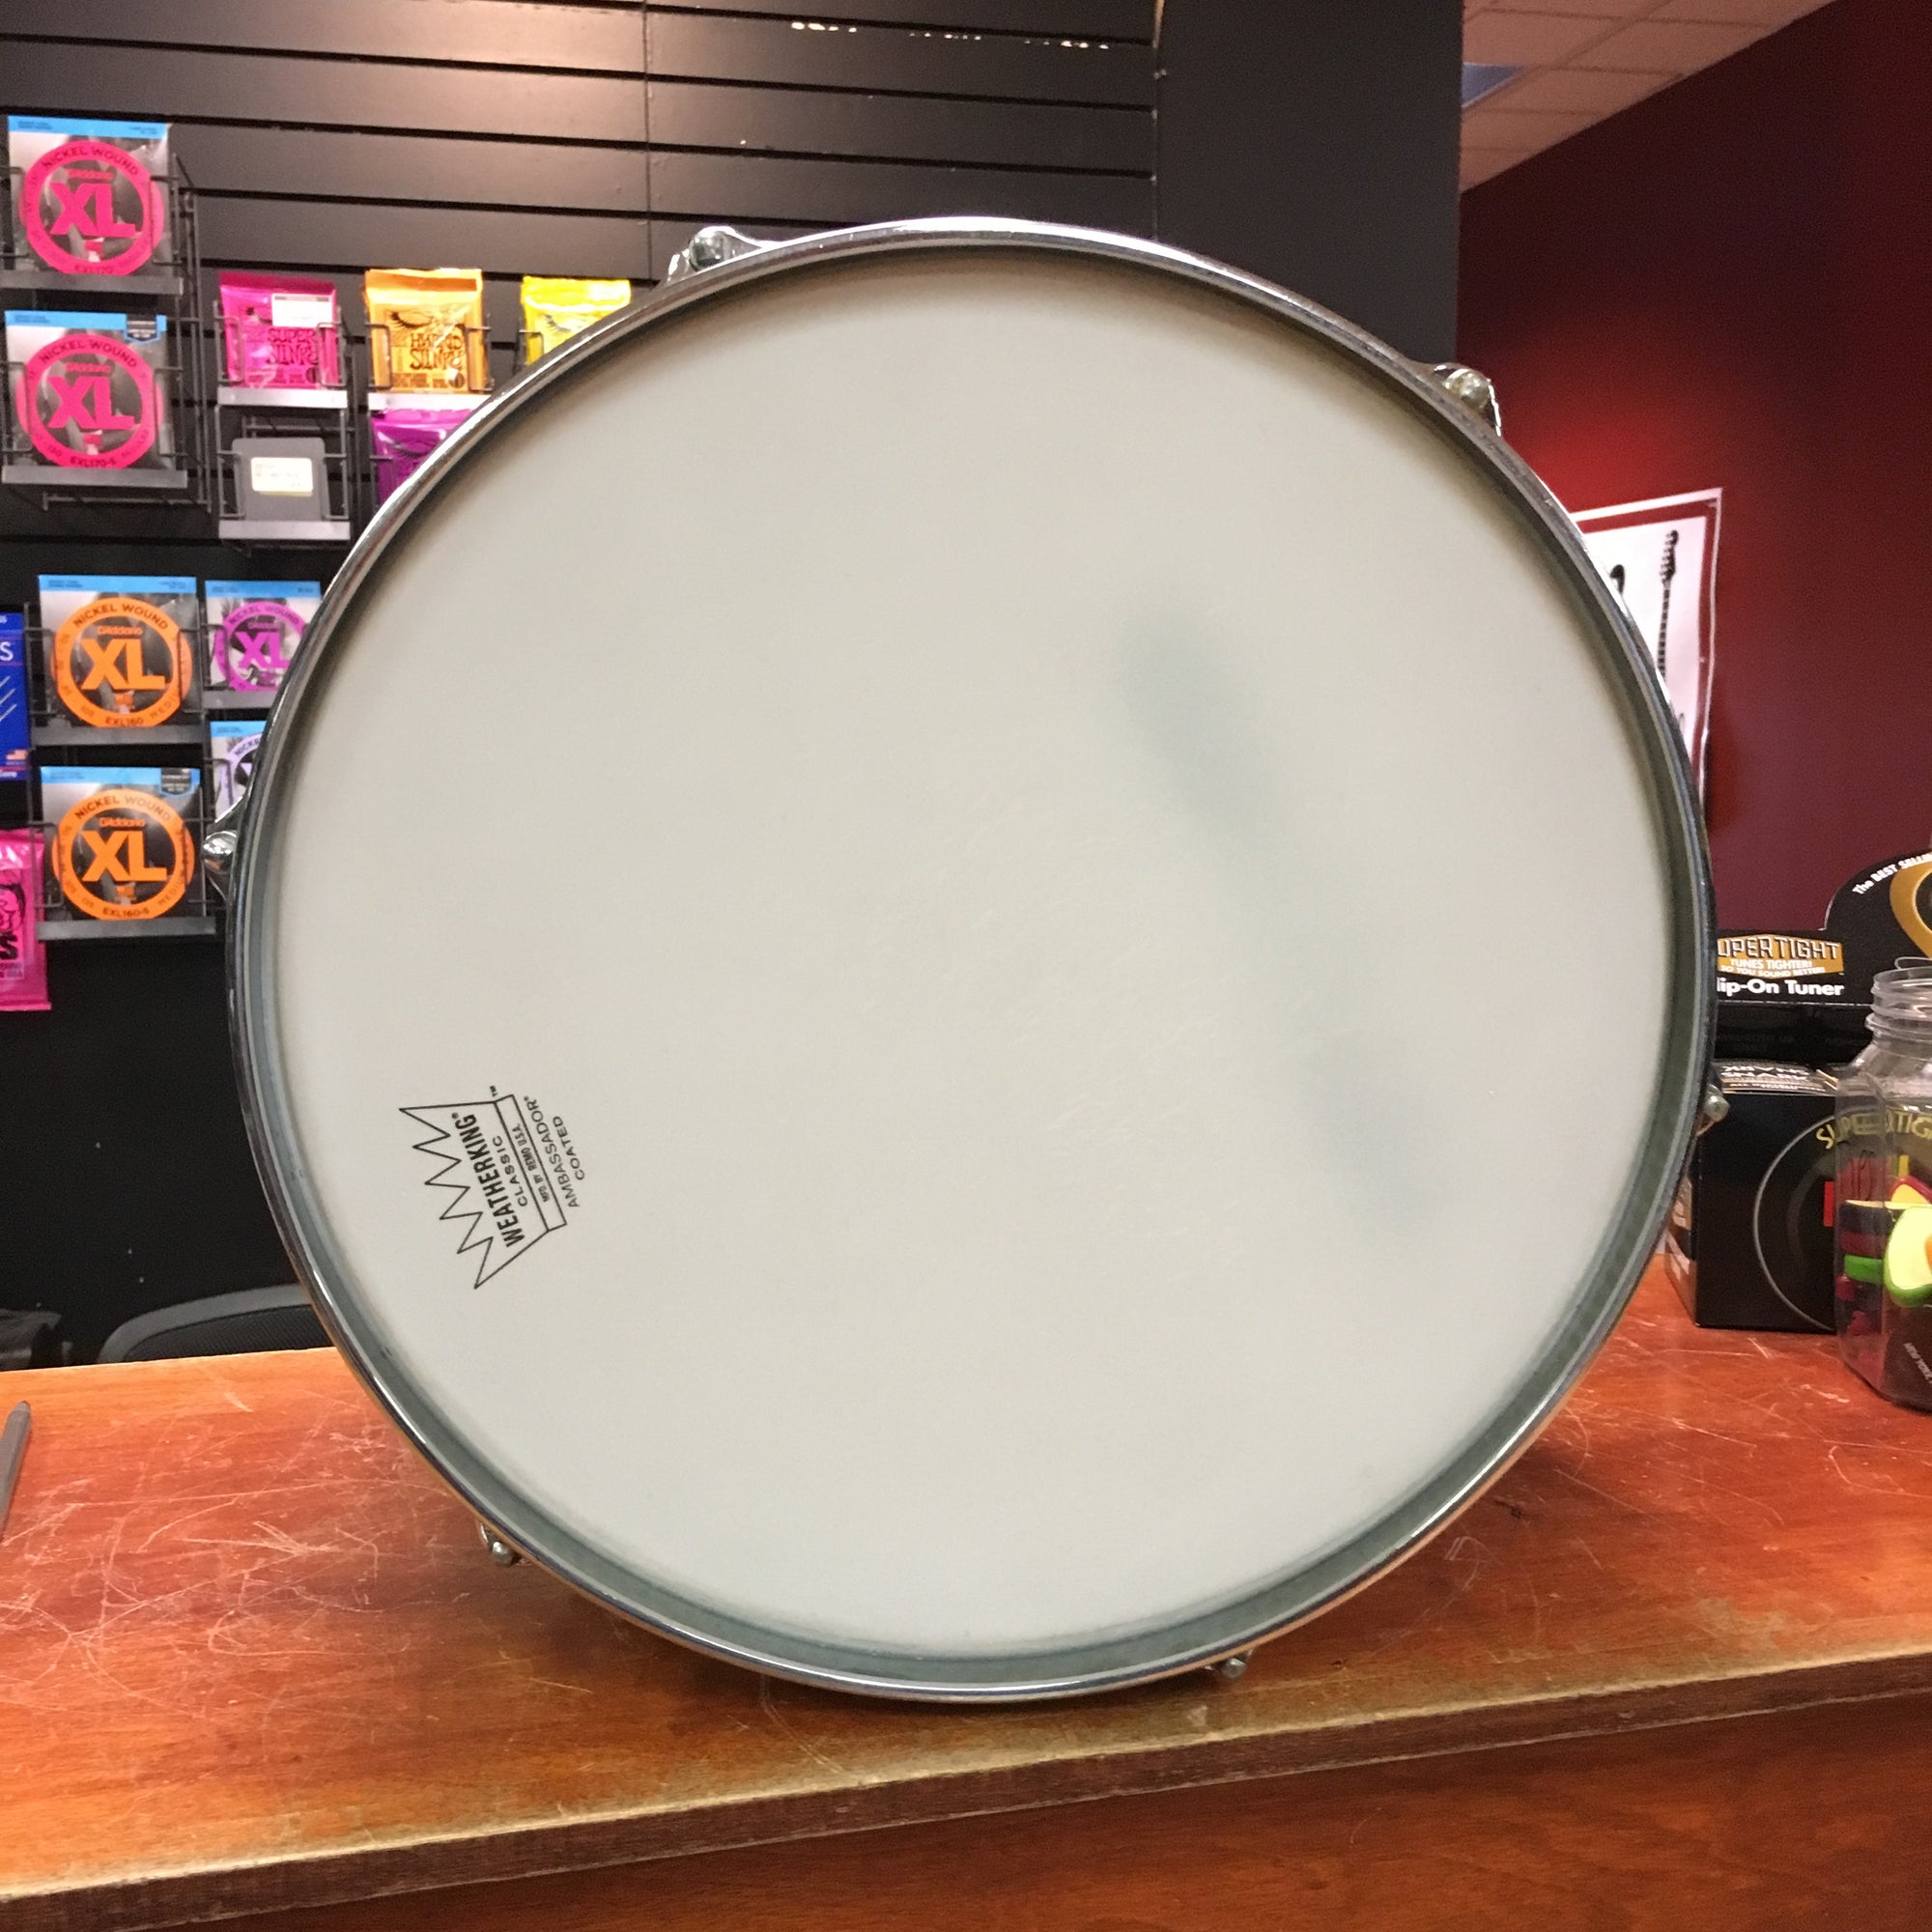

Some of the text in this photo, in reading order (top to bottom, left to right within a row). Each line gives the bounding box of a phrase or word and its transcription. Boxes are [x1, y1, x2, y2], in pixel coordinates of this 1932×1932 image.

[43, 147, 87, 168] NICKEL
[91, 148, 139, 177] WOUND
[50, 182, 136, 238] XL
[39, 339, 137, 368] NICKEL WOUND
[48, 375, 134, 430] XL
[72, 603, 168, 630] NICKEL WOUND
[80, 638, 166, 691] XL
[235, 631, 291, 668] XL
[234, 738, 260, 755] NICKE
[74, 795, 171, 821] NICKEL WOUND
[81, 830, 167, 882] XL
[1852, 880, 1874, 895] The
[1870, 864, 1898, 882] BEST
[1717, 935, 1840, 959] UPERTIGHT
[1730, 958, 1764, 970] TUNES
[1736, 967, 1757, 976] YOU
[1757, 969, 1791, 978] SOUND
[1717, 977, 1845, 997] lip-On Tuner
[520, 1147, 538, 1172] REMO
[526, 1097, 581, 1208] AMBASSADOR
[552, 1116, 585, 1180] COATED
[455, 1113, 526, 1247] WEATHERKING
[492, 1135, 528, 1208] CLASSIC
[533, 1174, 545, 1184] BY
